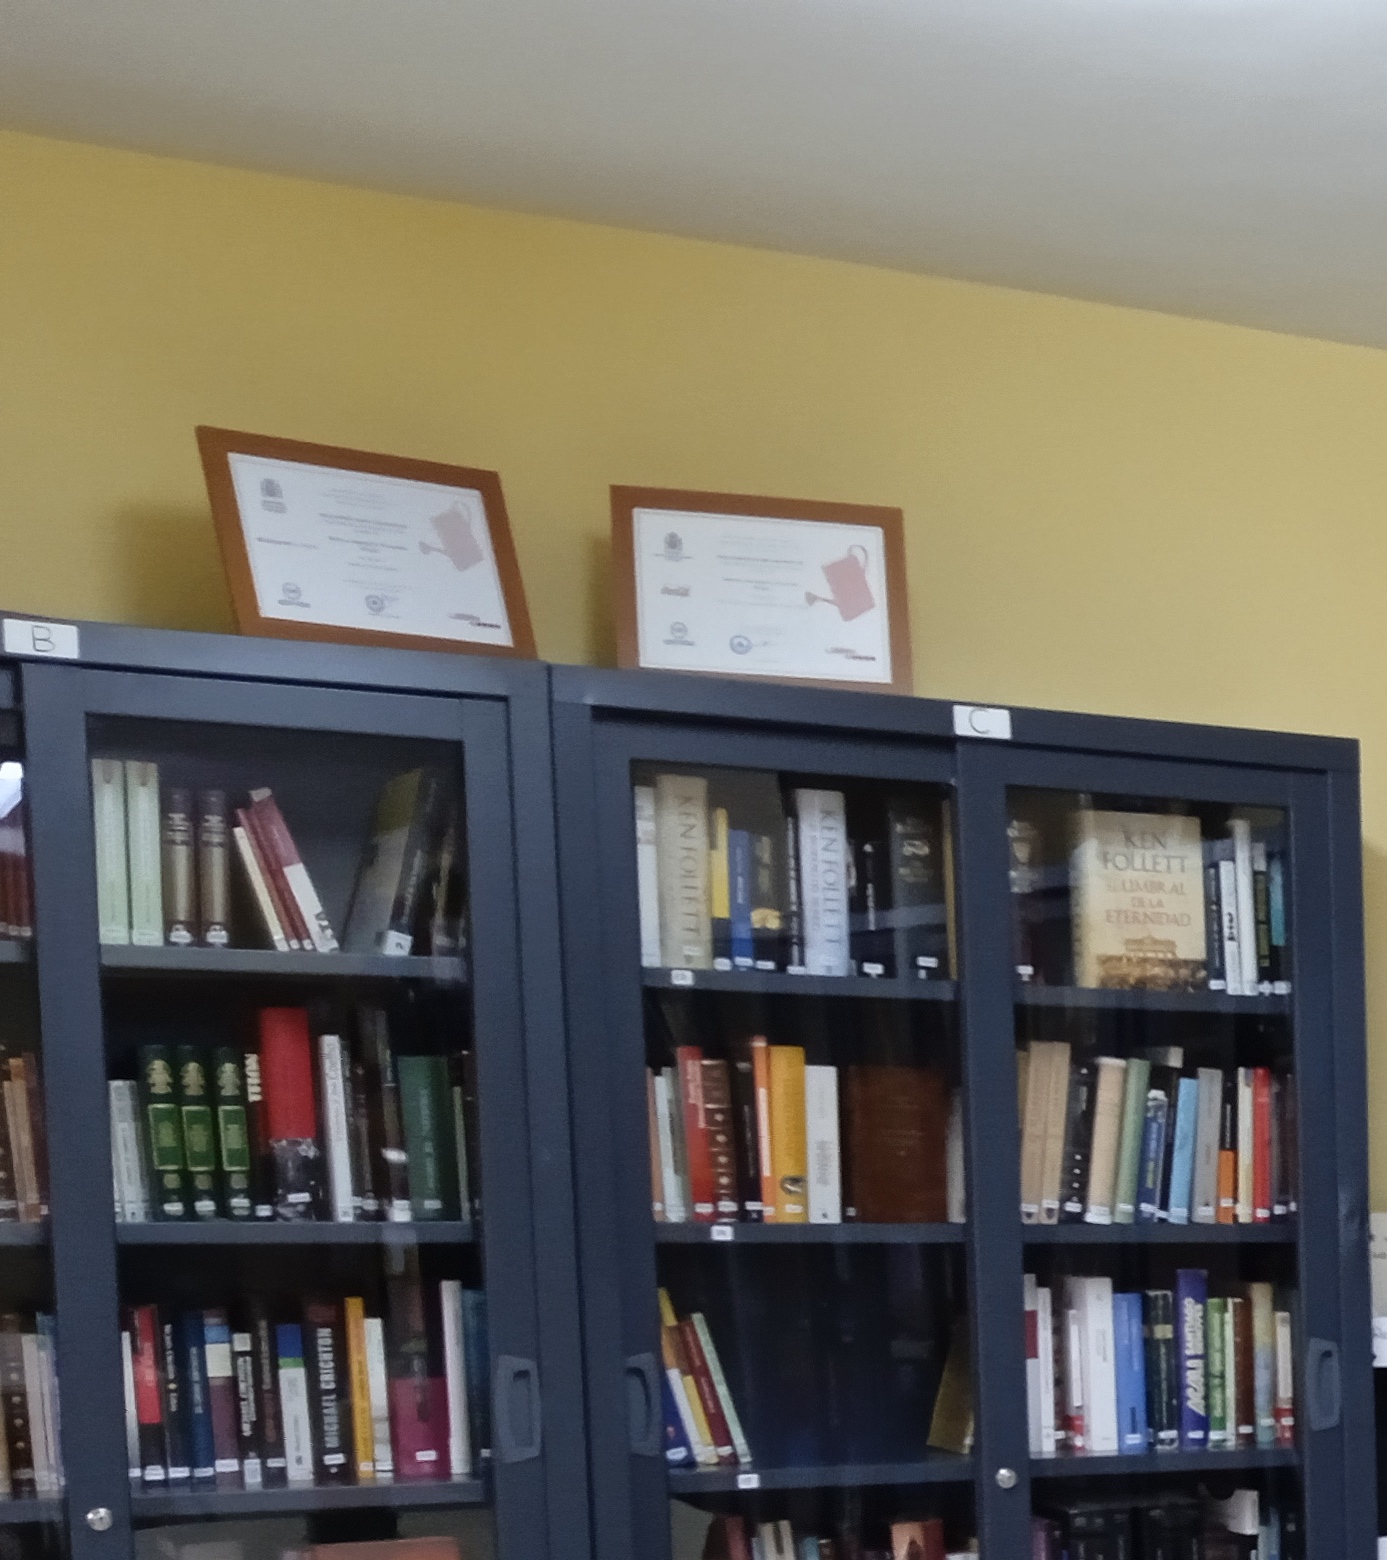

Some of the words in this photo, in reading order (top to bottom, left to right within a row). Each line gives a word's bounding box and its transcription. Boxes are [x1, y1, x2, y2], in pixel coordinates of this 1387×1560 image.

[32, 624, 53, 652] B
[970, 707, 991, 734] C
[677, 795, 700, 839] KEN
[818, 808, 843, 852] KEN
[1121, 830, 1168, 849] KEN
[1103, 849, 1188, 875] FOLLETT
[678, 845, 702, 938] FOLLETT
[820, 858, 845, 946] FOLLETT
[1105, 909, 1192, 927] ETERNIDAD
